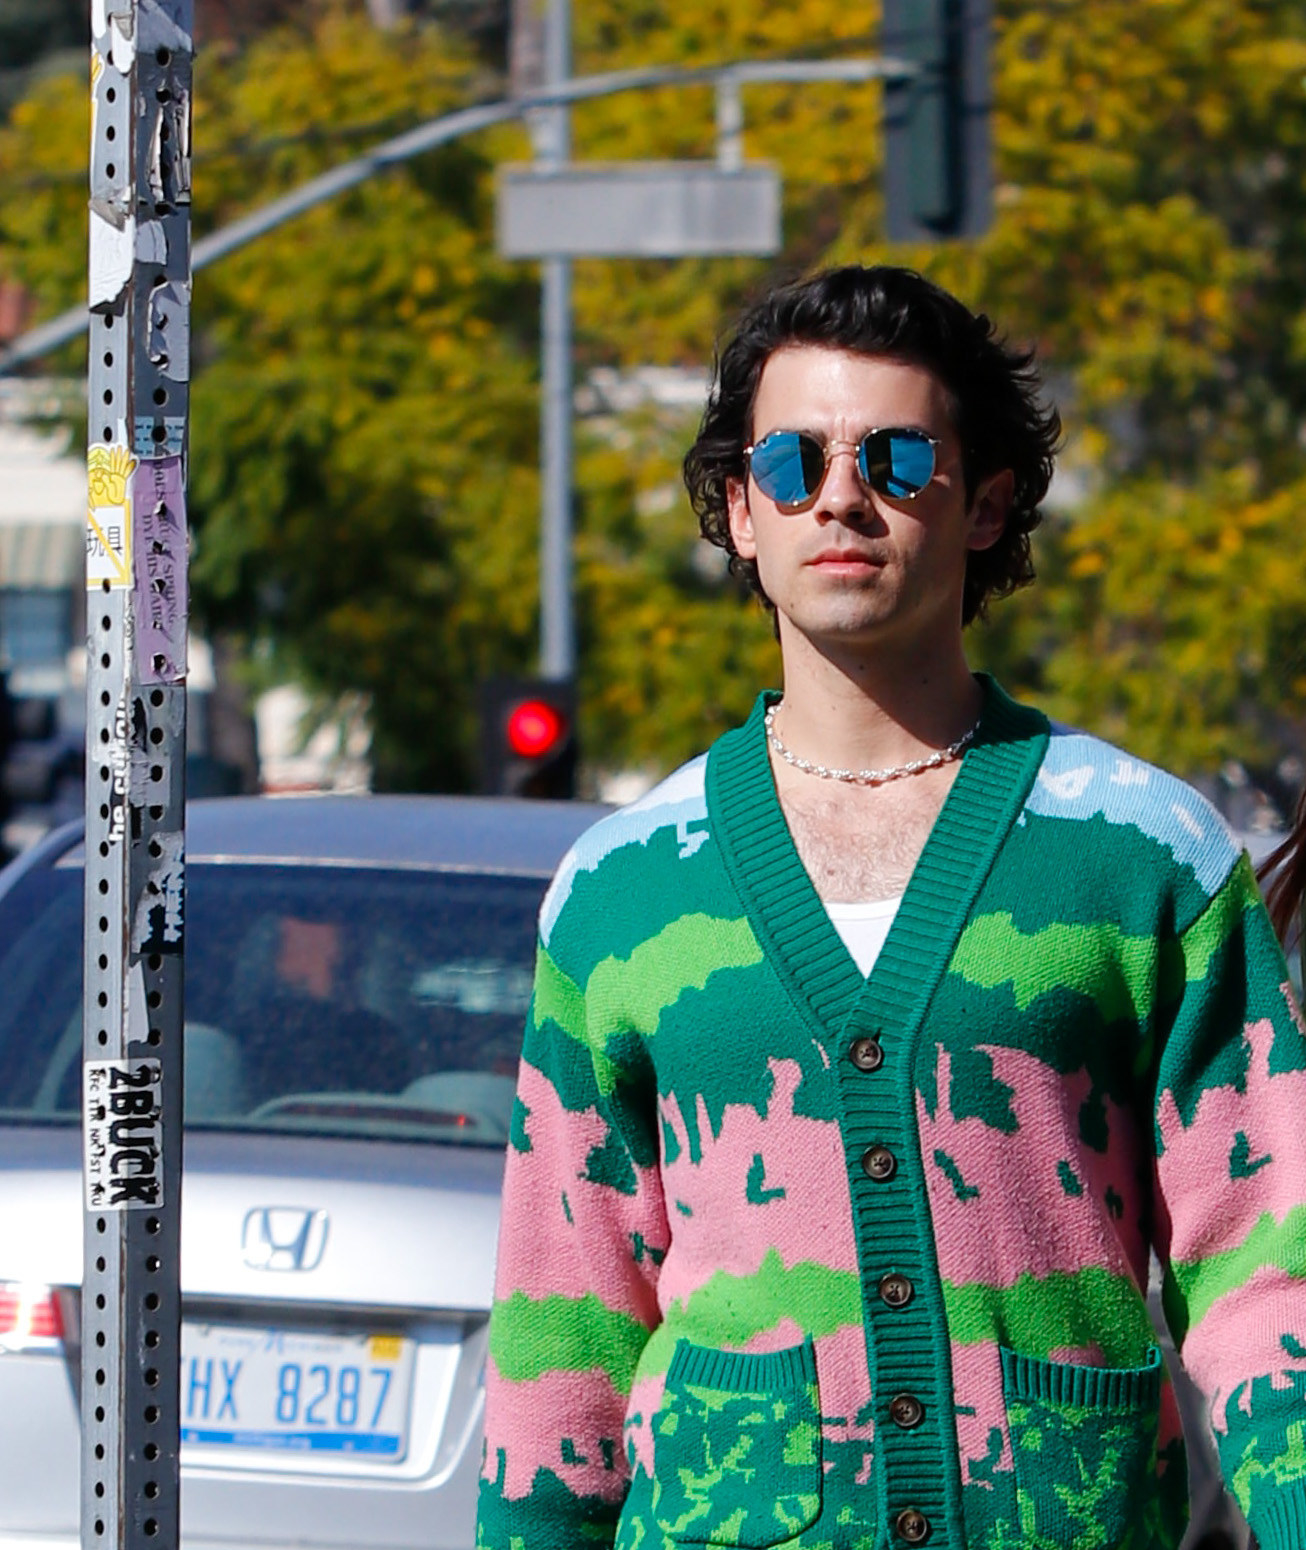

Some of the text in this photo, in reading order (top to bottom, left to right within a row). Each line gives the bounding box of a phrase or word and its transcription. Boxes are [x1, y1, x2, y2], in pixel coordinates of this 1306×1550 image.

[108, 1064, 157, 1205] 2BUCK
[181, 1355, 395, 1429] HX 8287
